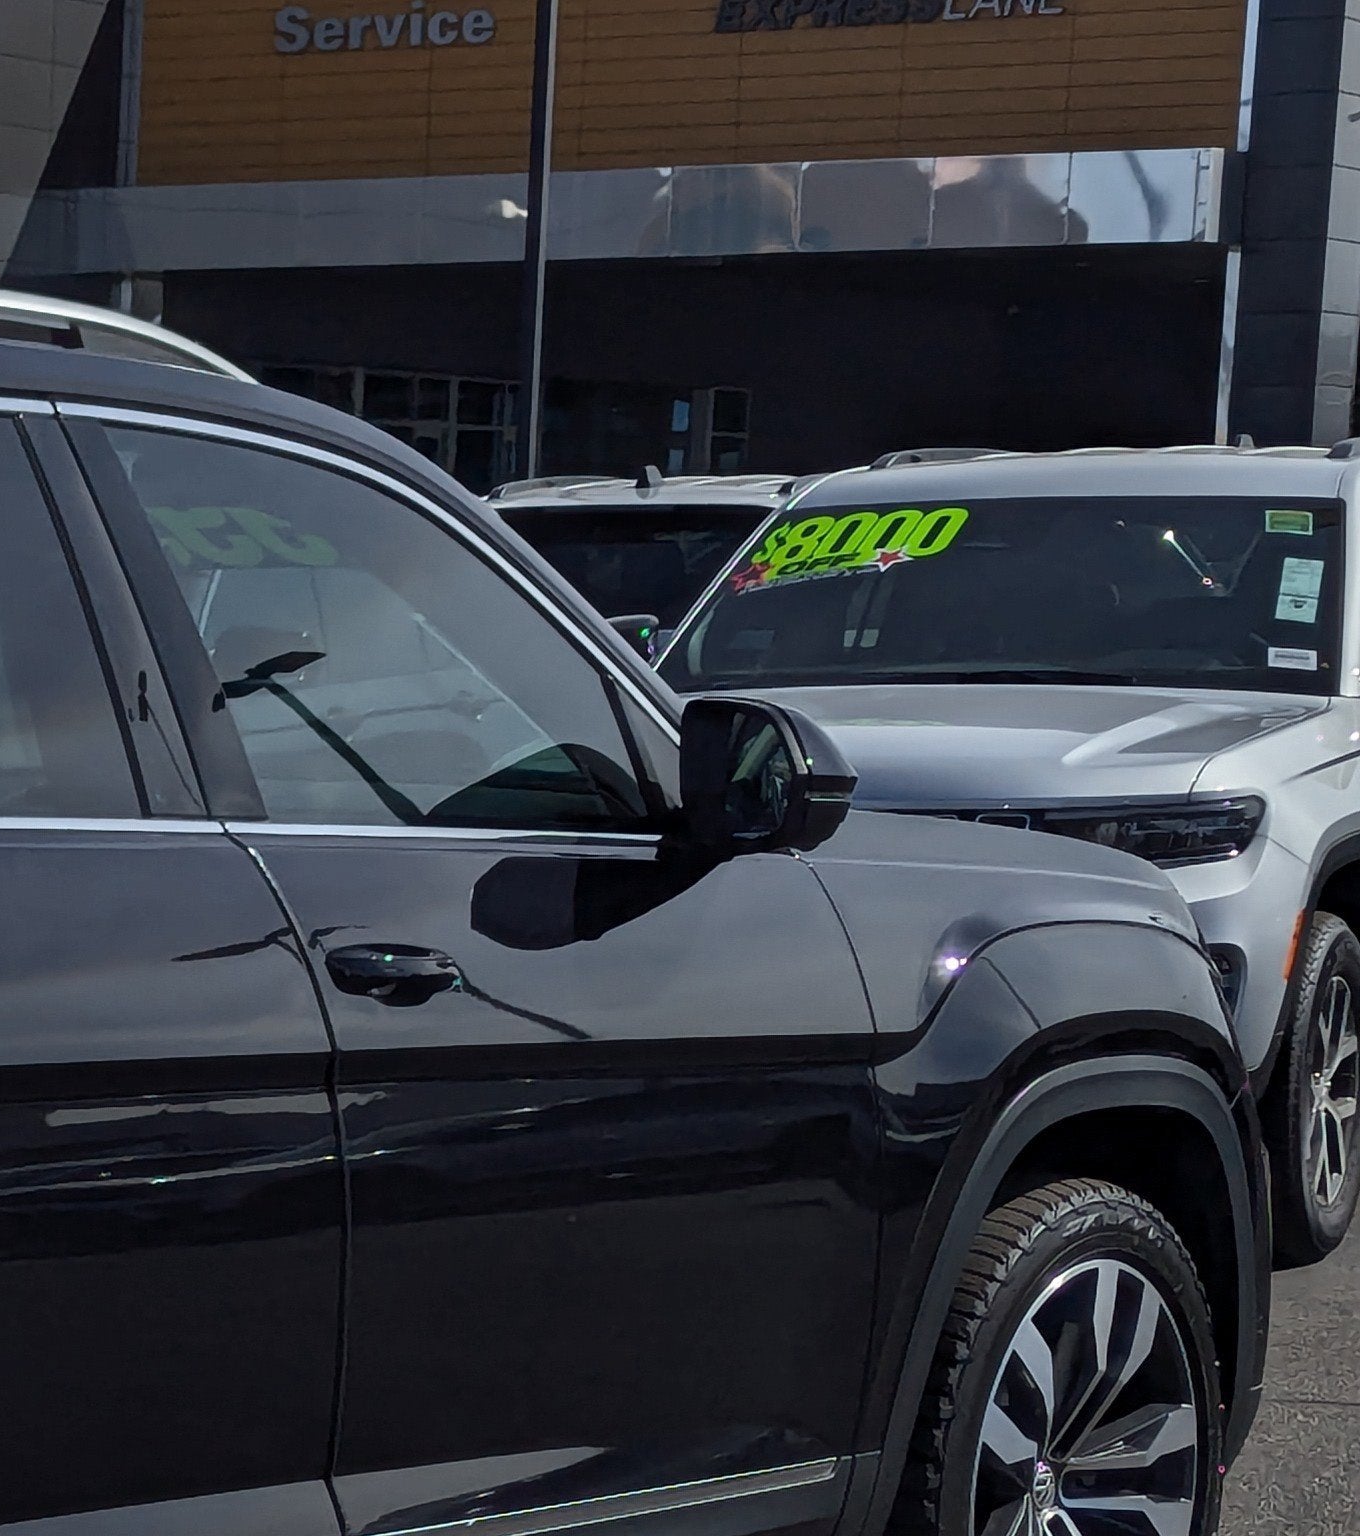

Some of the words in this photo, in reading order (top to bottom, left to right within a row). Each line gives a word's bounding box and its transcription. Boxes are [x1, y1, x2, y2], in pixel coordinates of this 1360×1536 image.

[274, 1, 495, 53] Service
[751, 507, 970, 572] $8000
[776, 552, 862, 576] OFF
